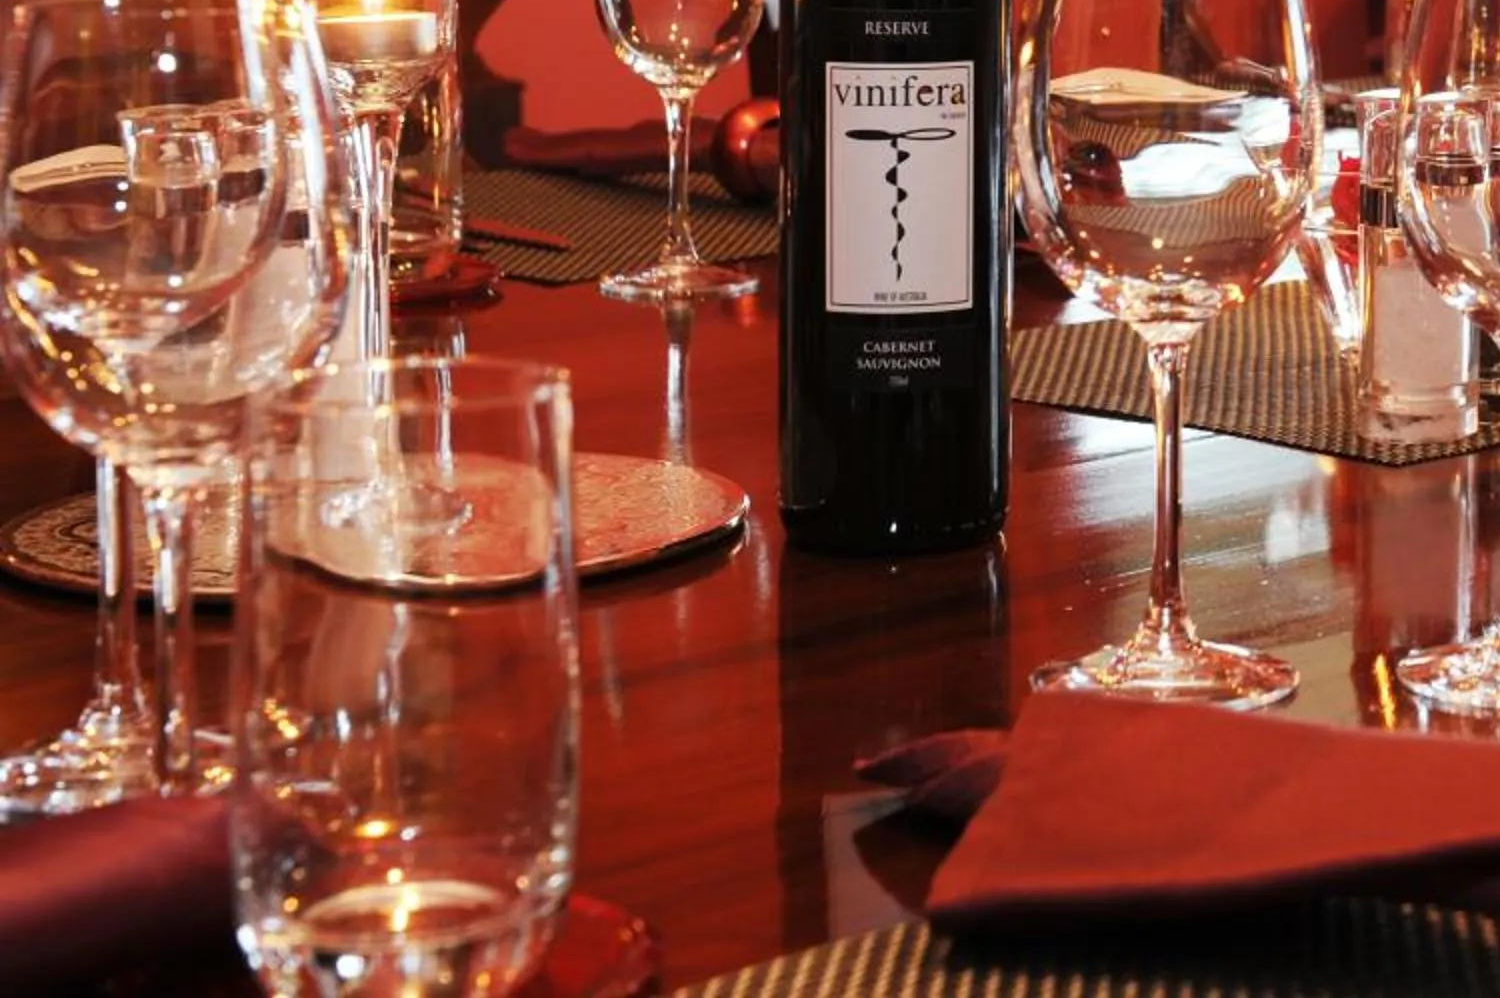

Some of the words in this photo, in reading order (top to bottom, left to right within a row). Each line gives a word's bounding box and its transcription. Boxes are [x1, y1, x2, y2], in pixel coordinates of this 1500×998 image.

[865, 20, 930, 36] RESERVE
[834, 74, 967, 107] vinifera
[863, 340, 936, 353] CABERNET
[856, 355, 942, 371] SAUVIGNON
